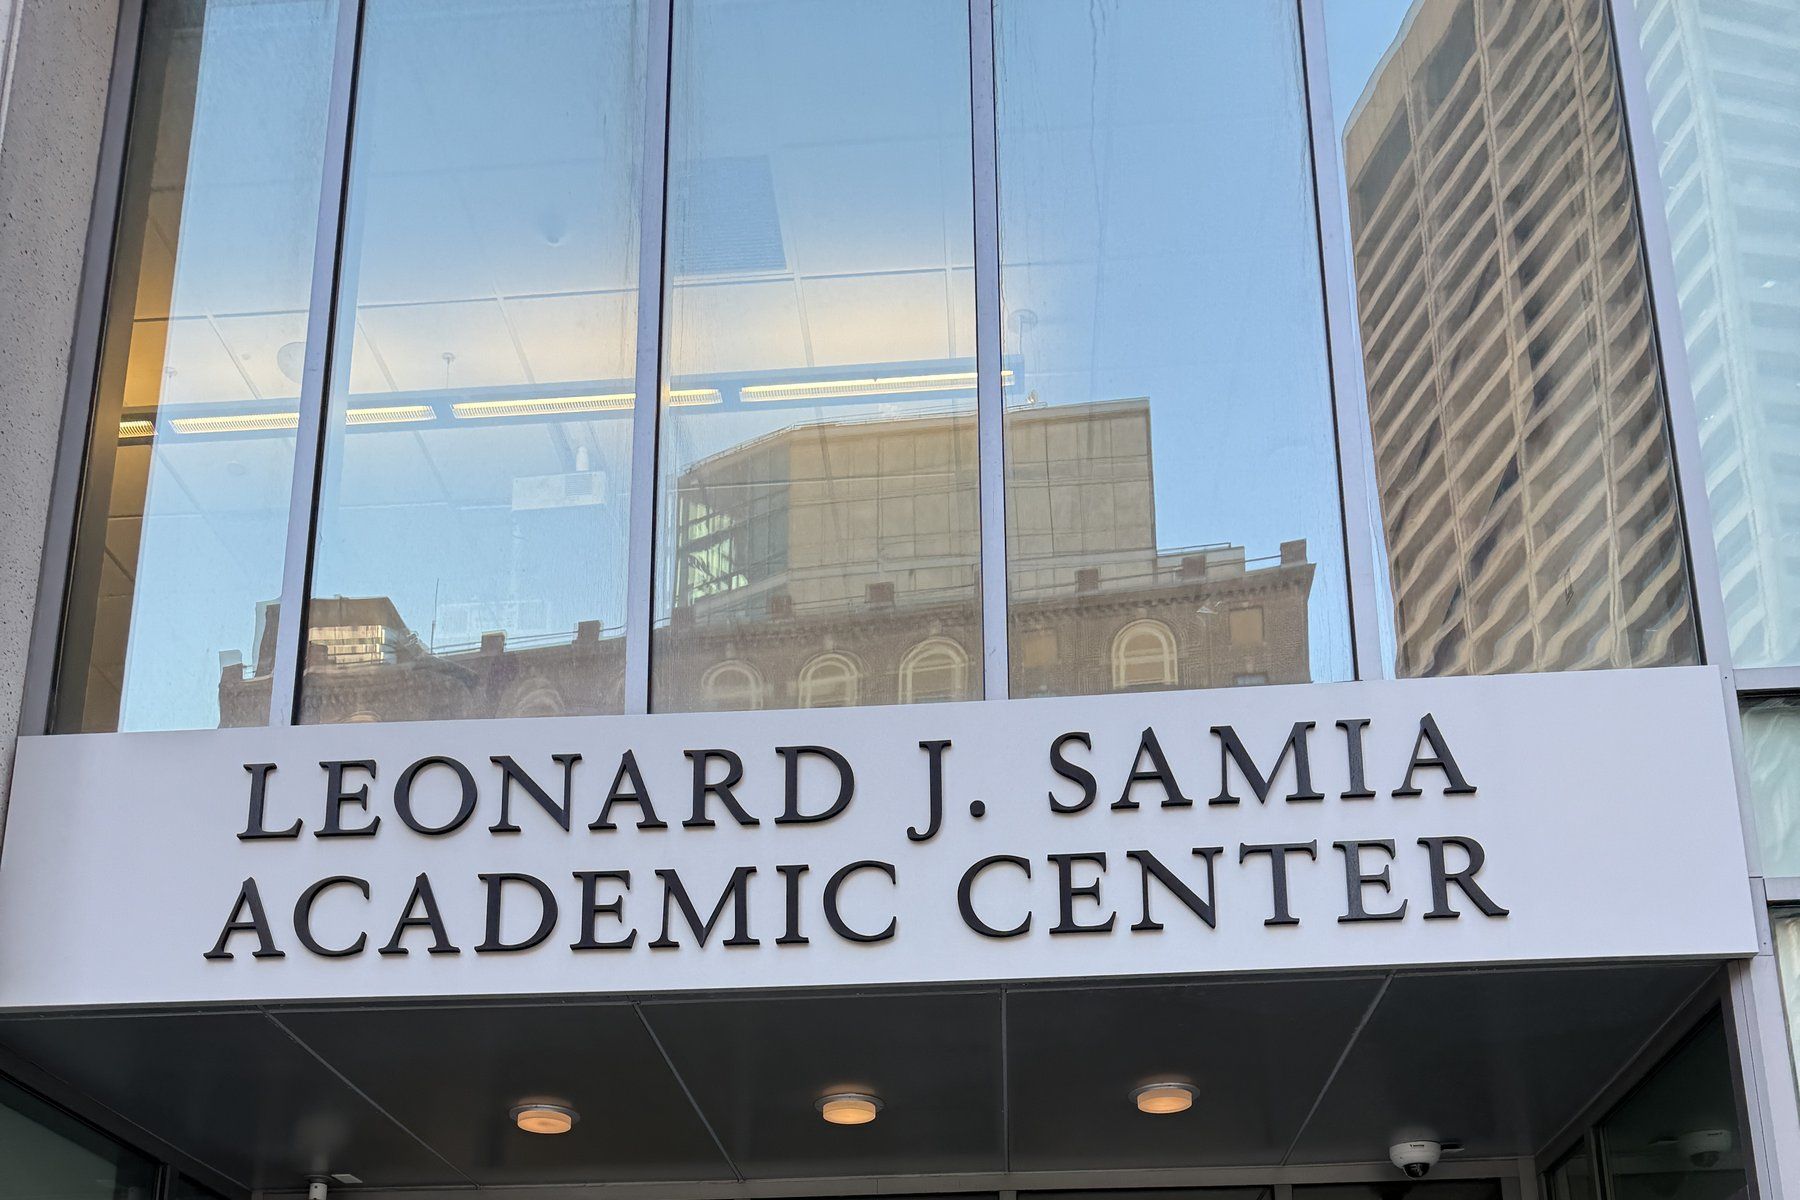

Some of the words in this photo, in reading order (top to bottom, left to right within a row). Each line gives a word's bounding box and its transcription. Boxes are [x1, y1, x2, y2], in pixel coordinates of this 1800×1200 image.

[237, 745, 855, 841] LEONARD
[906, 739, 986, 842] J.
[1048, 712, 1478, 814] SAMIA
[203, 859, 898, 960] ACADEMIC
[956, 835, 1510, 938] CENTER
